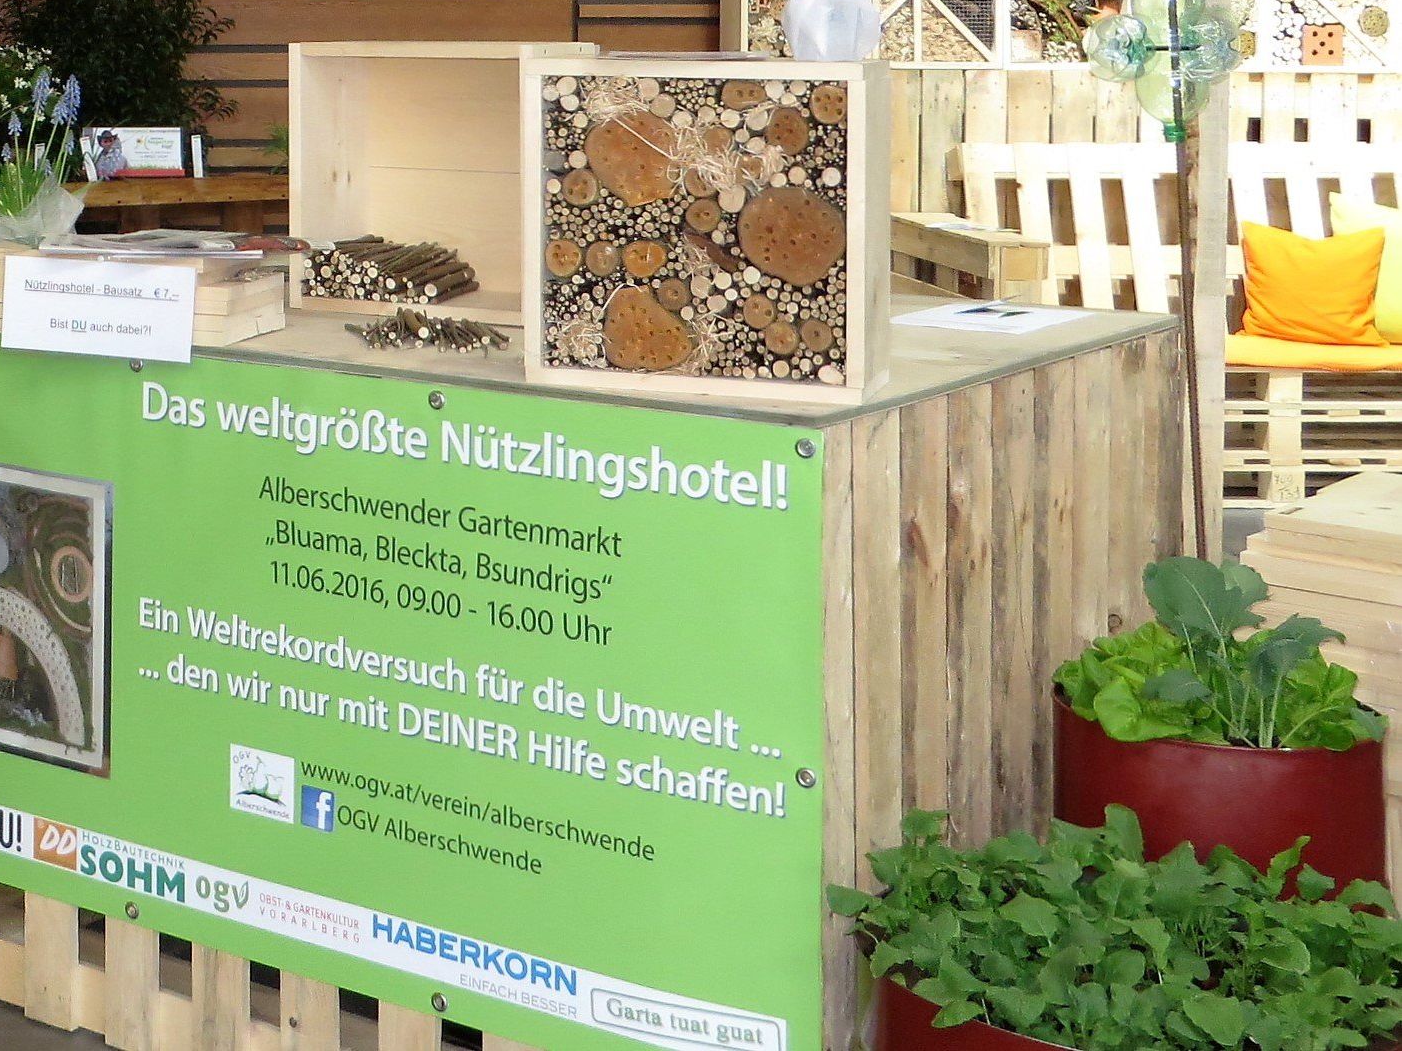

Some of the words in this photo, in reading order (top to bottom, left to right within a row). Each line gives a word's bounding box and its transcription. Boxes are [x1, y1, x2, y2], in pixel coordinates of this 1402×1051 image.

[24, 279, 95, 294] Nützlingshotel
[103, 284, 143, 298] Bausatz
[153, 287, 161, 298] €
[50, 318, 69, 329] Bist
[71, 319, 87, 330] DU
[90, 320, 114, 332] auch
[116, 322, 152, 336] dabei?!
[141, 380, 207, 428] Das
[216, 395, 429, 460] weltgrößte
[440, 419, 789, 510] Nützlingshotel!
[258, 475, 452, 529] Alberschwender
[458, 505, 623, 558] Gartenmarkt
[265, 519, 369, 562] „Bluama,
[375, 534, 468, 580] Bleckta,
[270, 560, 390, 610] 11.06.2016,
[397, 583, 462, 619] 09.00
[487, 600, 554, 636] 16.00
[562, 611, 613, 647] Uhr
[138, 596, 180, 634] Ein
[185, 605, 468, 695] Weltrekordversuch
[476, 663, 524, 706] für
[532, 676, 586, 719] die
[596, 687, 741, 751] Umwelt
[166, 653, 220, 694] den
[226, 670, 273, 704] wir
[279, 684, 331, 718] nur
[338, 695, 390, 732] mit
[398, 702, 520, 761] DEINER
[528, 729, 608, 781] Hilfe
[616, 754, 787, 819] schaffen!
[300, 759, 656, 862] www.ogv.at/verein/alberschwende
[337, 804, 380, 834] OGV
[384, 817, 543, 875] Alberschwende
[79, 843, 186, 904] SOHM
[195, 874, 250, 914] ogv
[293, 902, 360, 930] GARTENKULTUR
[371, 912, 578, 997] HABERKORN
[459, 972, 518, 1004] EINFACH
[521, 989, 578, 1020] BESSER
[605, 997, 663, 1027] Garta
[670, 1012, 711, 1036] tuat
[716, 1023, 764, 1045] guat
